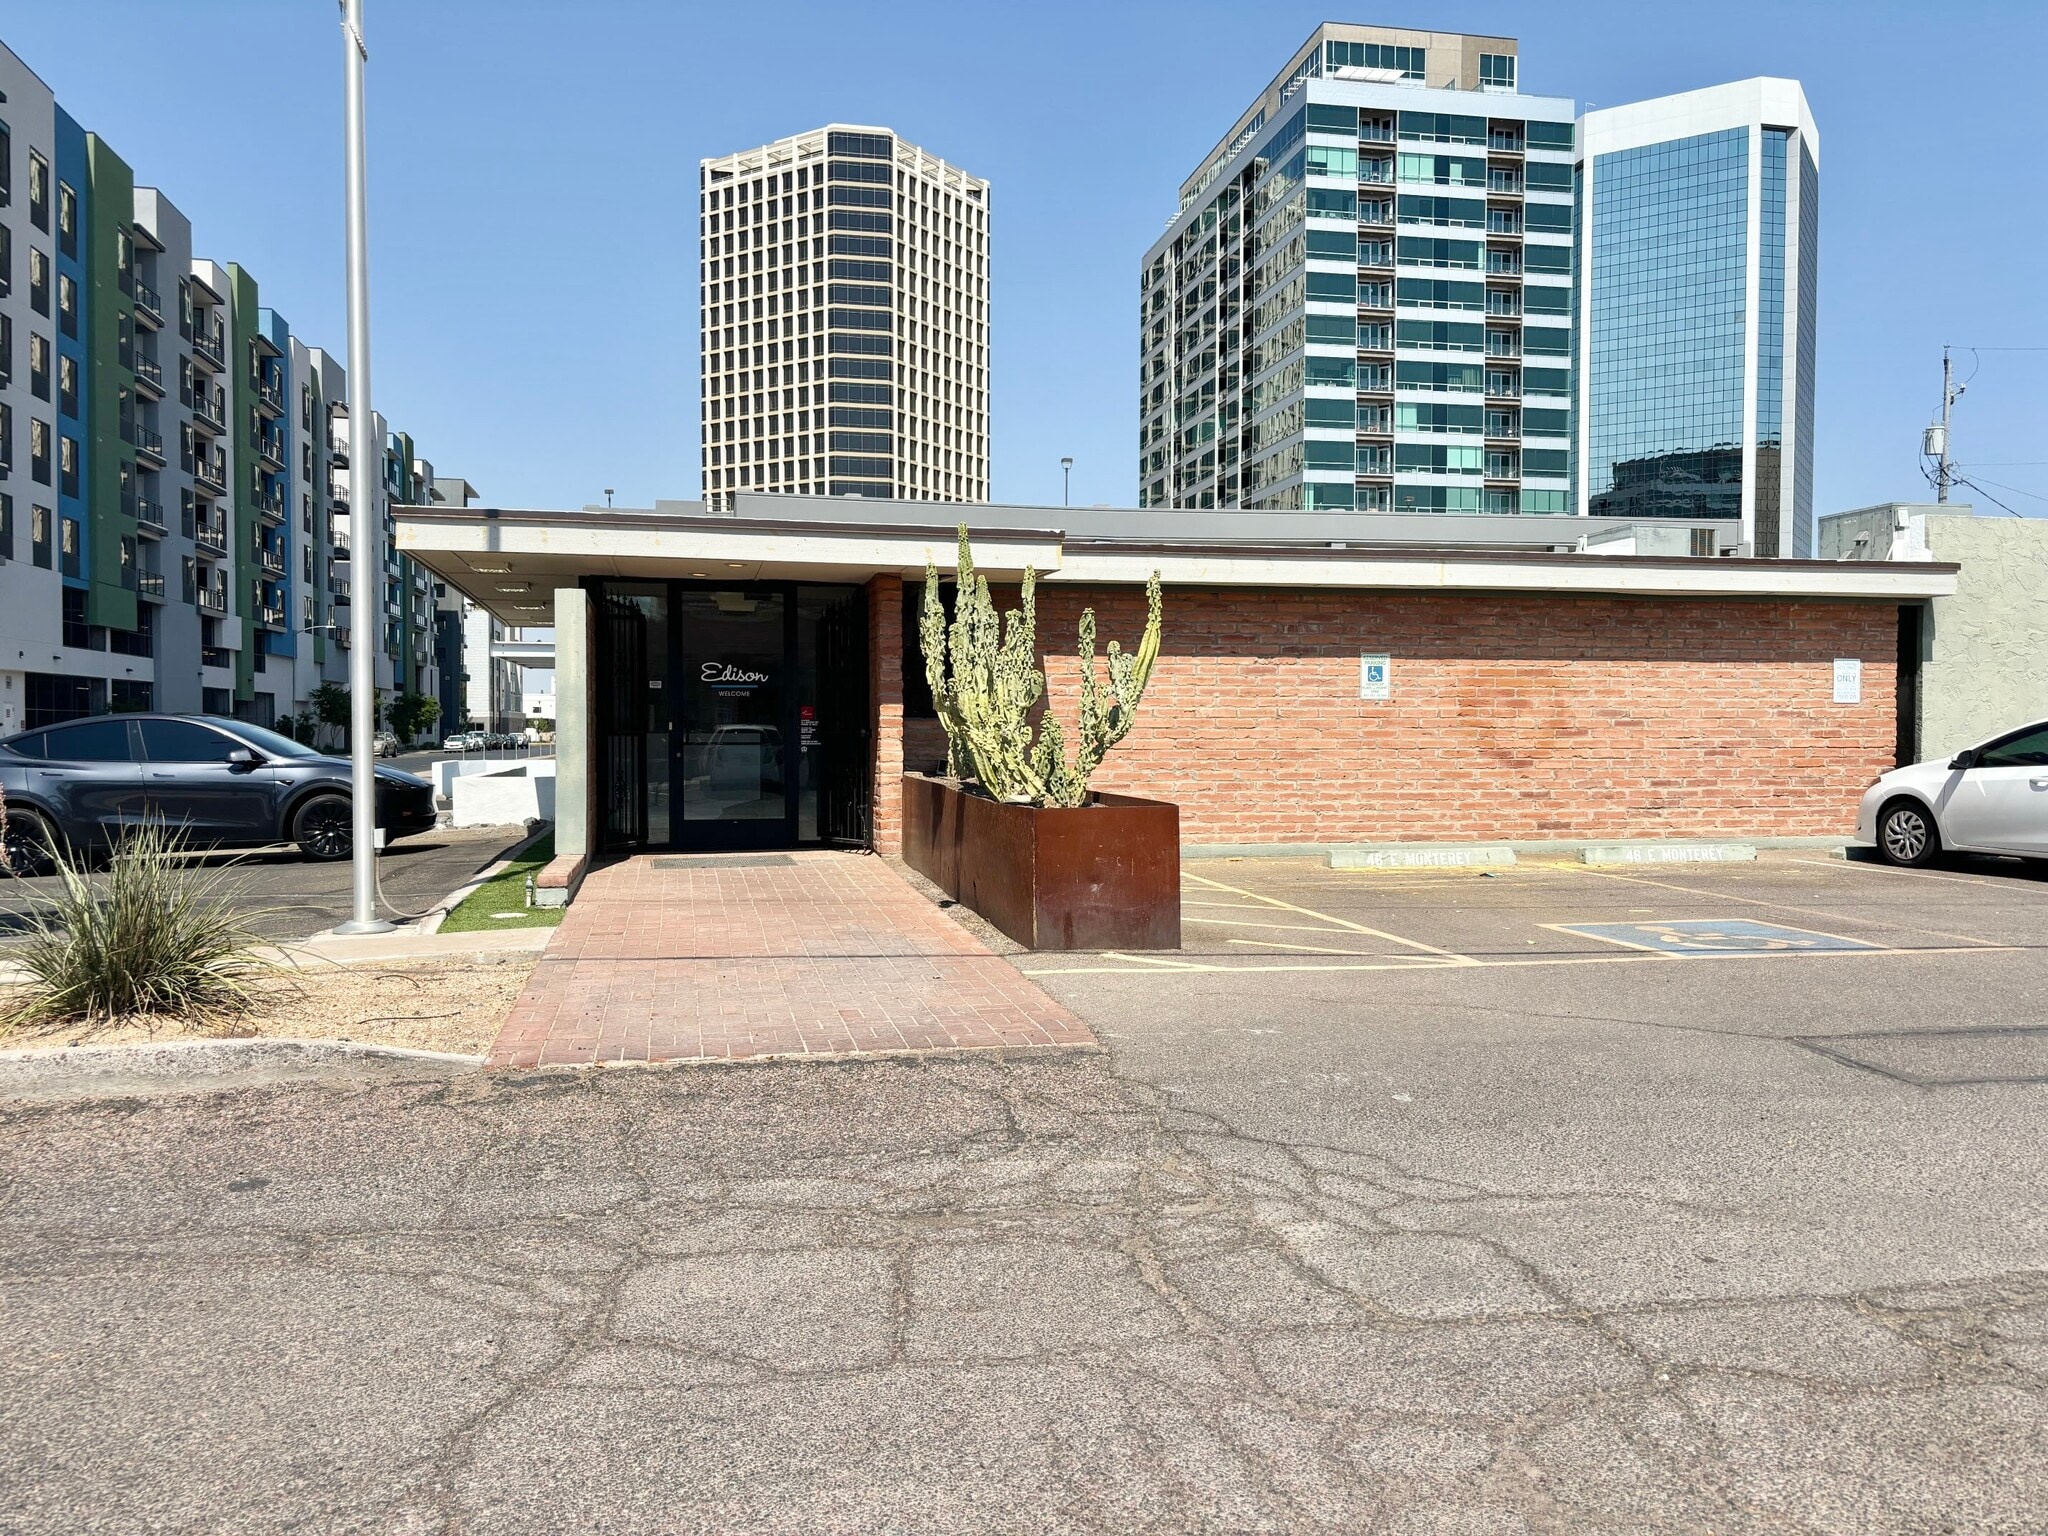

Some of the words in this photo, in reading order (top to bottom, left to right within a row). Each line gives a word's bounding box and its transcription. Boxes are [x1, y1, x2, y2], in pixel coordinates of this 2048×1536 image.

[700, 662, 769, 682] Edison
[1836, 674, 1856, 682] ONLY
[1366, 853, 1382, 866] 46
[1390, 853, 1400, 866] E
[1405, 851, 1471, 866] MONTEREY
[1625, 849, 1640, 861] 46
[1647, 849, 1656, 861] E
[1662, 847, 1723, 861] MONTEREY
